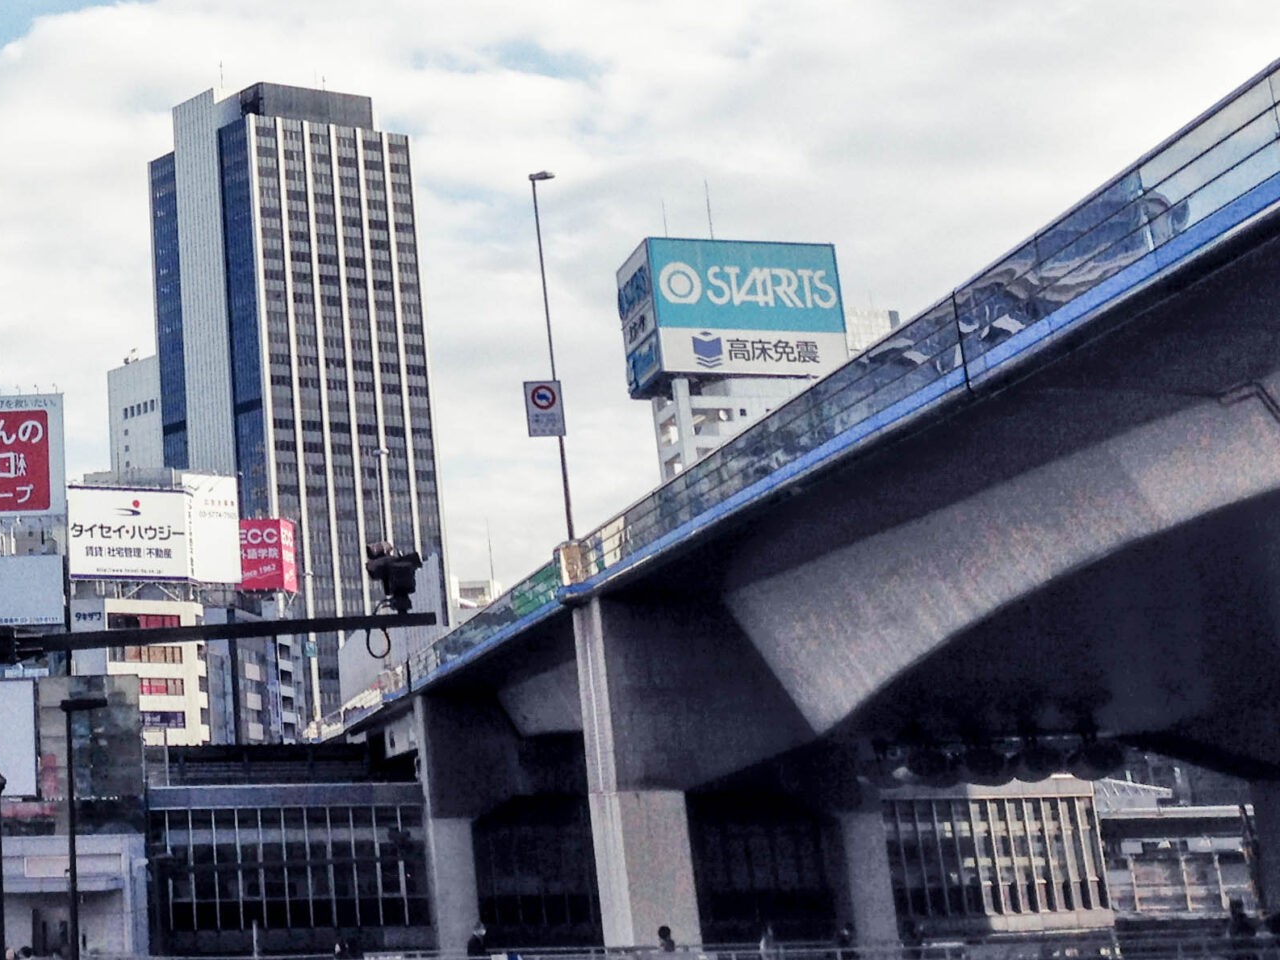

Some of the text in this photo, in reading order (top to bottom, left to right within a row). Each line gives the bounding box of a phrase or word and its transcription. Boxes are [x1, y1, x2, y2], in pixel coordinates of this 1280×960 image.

[706, 265, 838, 309] STARTS
[726, 338, 821, 364] 高床免震
[71, 522, 185, 540] タイセイ・ハウジー
[85, 546, 173, 559] 賃貸 社宅管理 不動産
